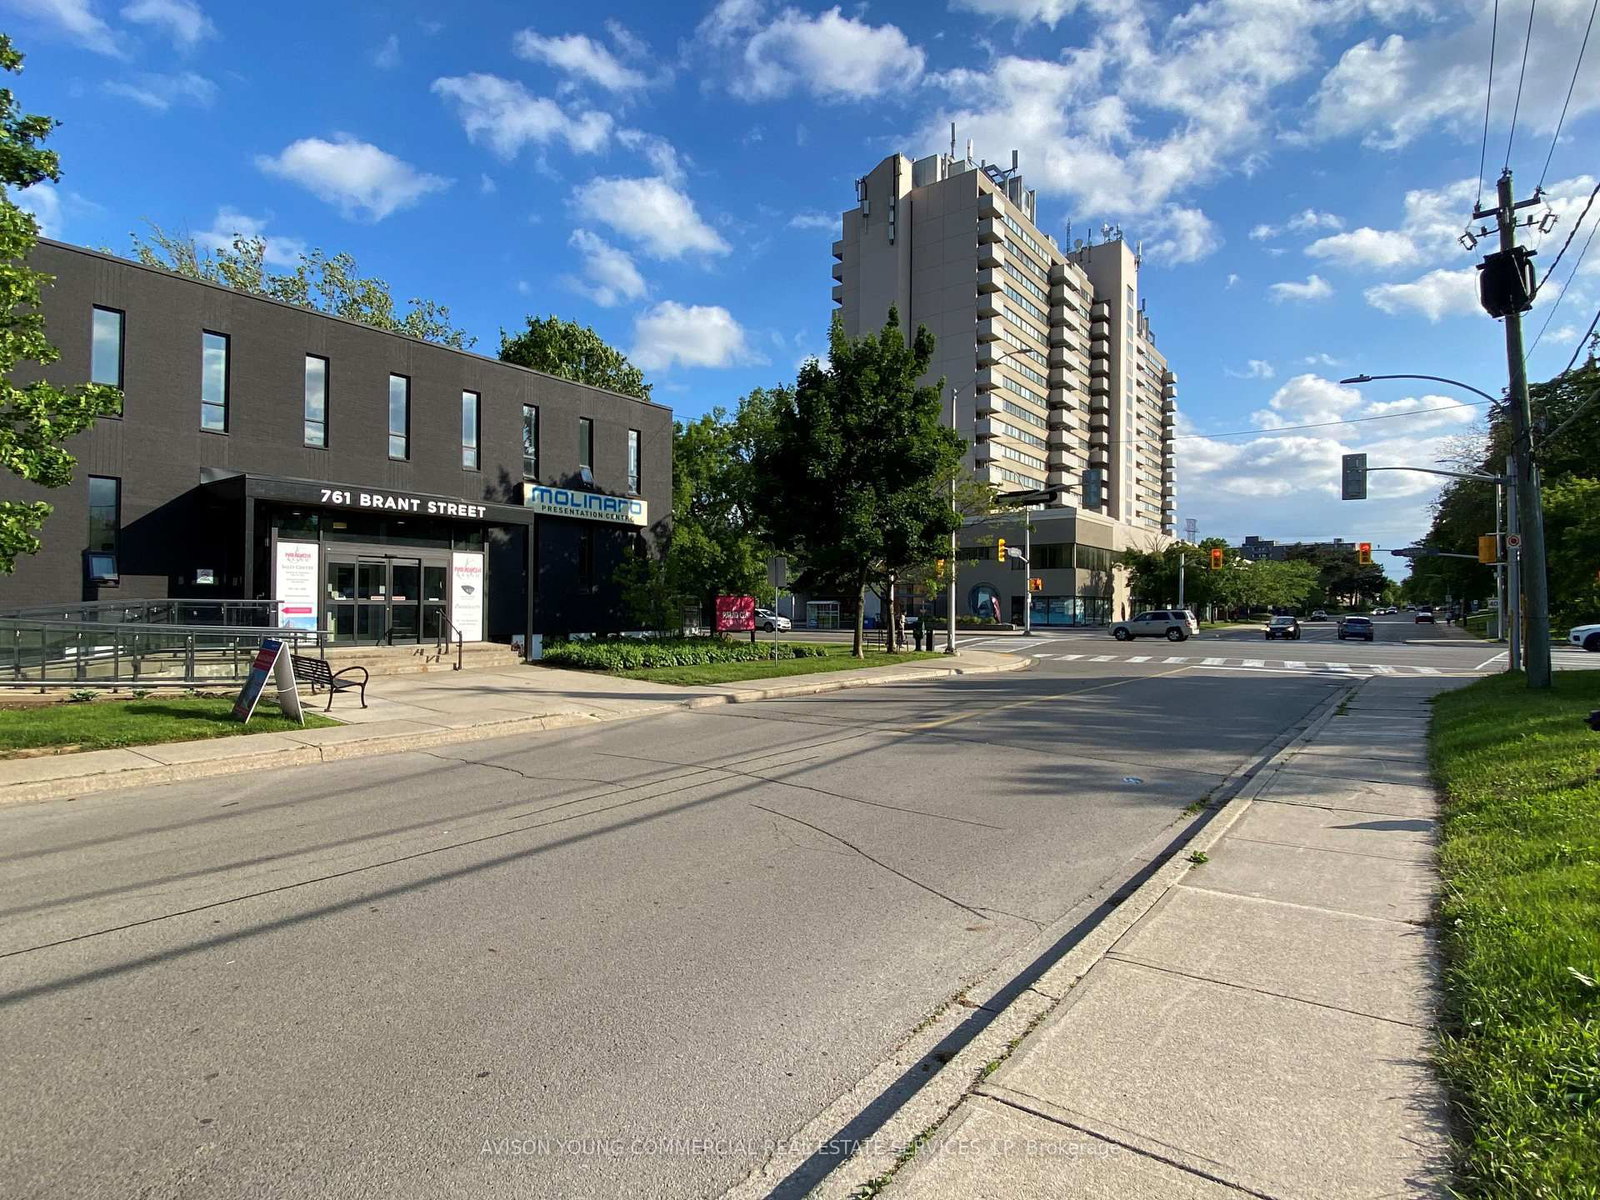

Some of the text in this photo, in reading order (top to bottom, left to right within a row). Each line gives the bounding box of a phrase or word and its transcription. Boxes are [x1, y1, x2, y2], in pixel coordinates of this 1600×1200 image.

[320, 489, 487, 518] 761 BRANT STREET
[541, 504, 603, 518] PRESENTATION
